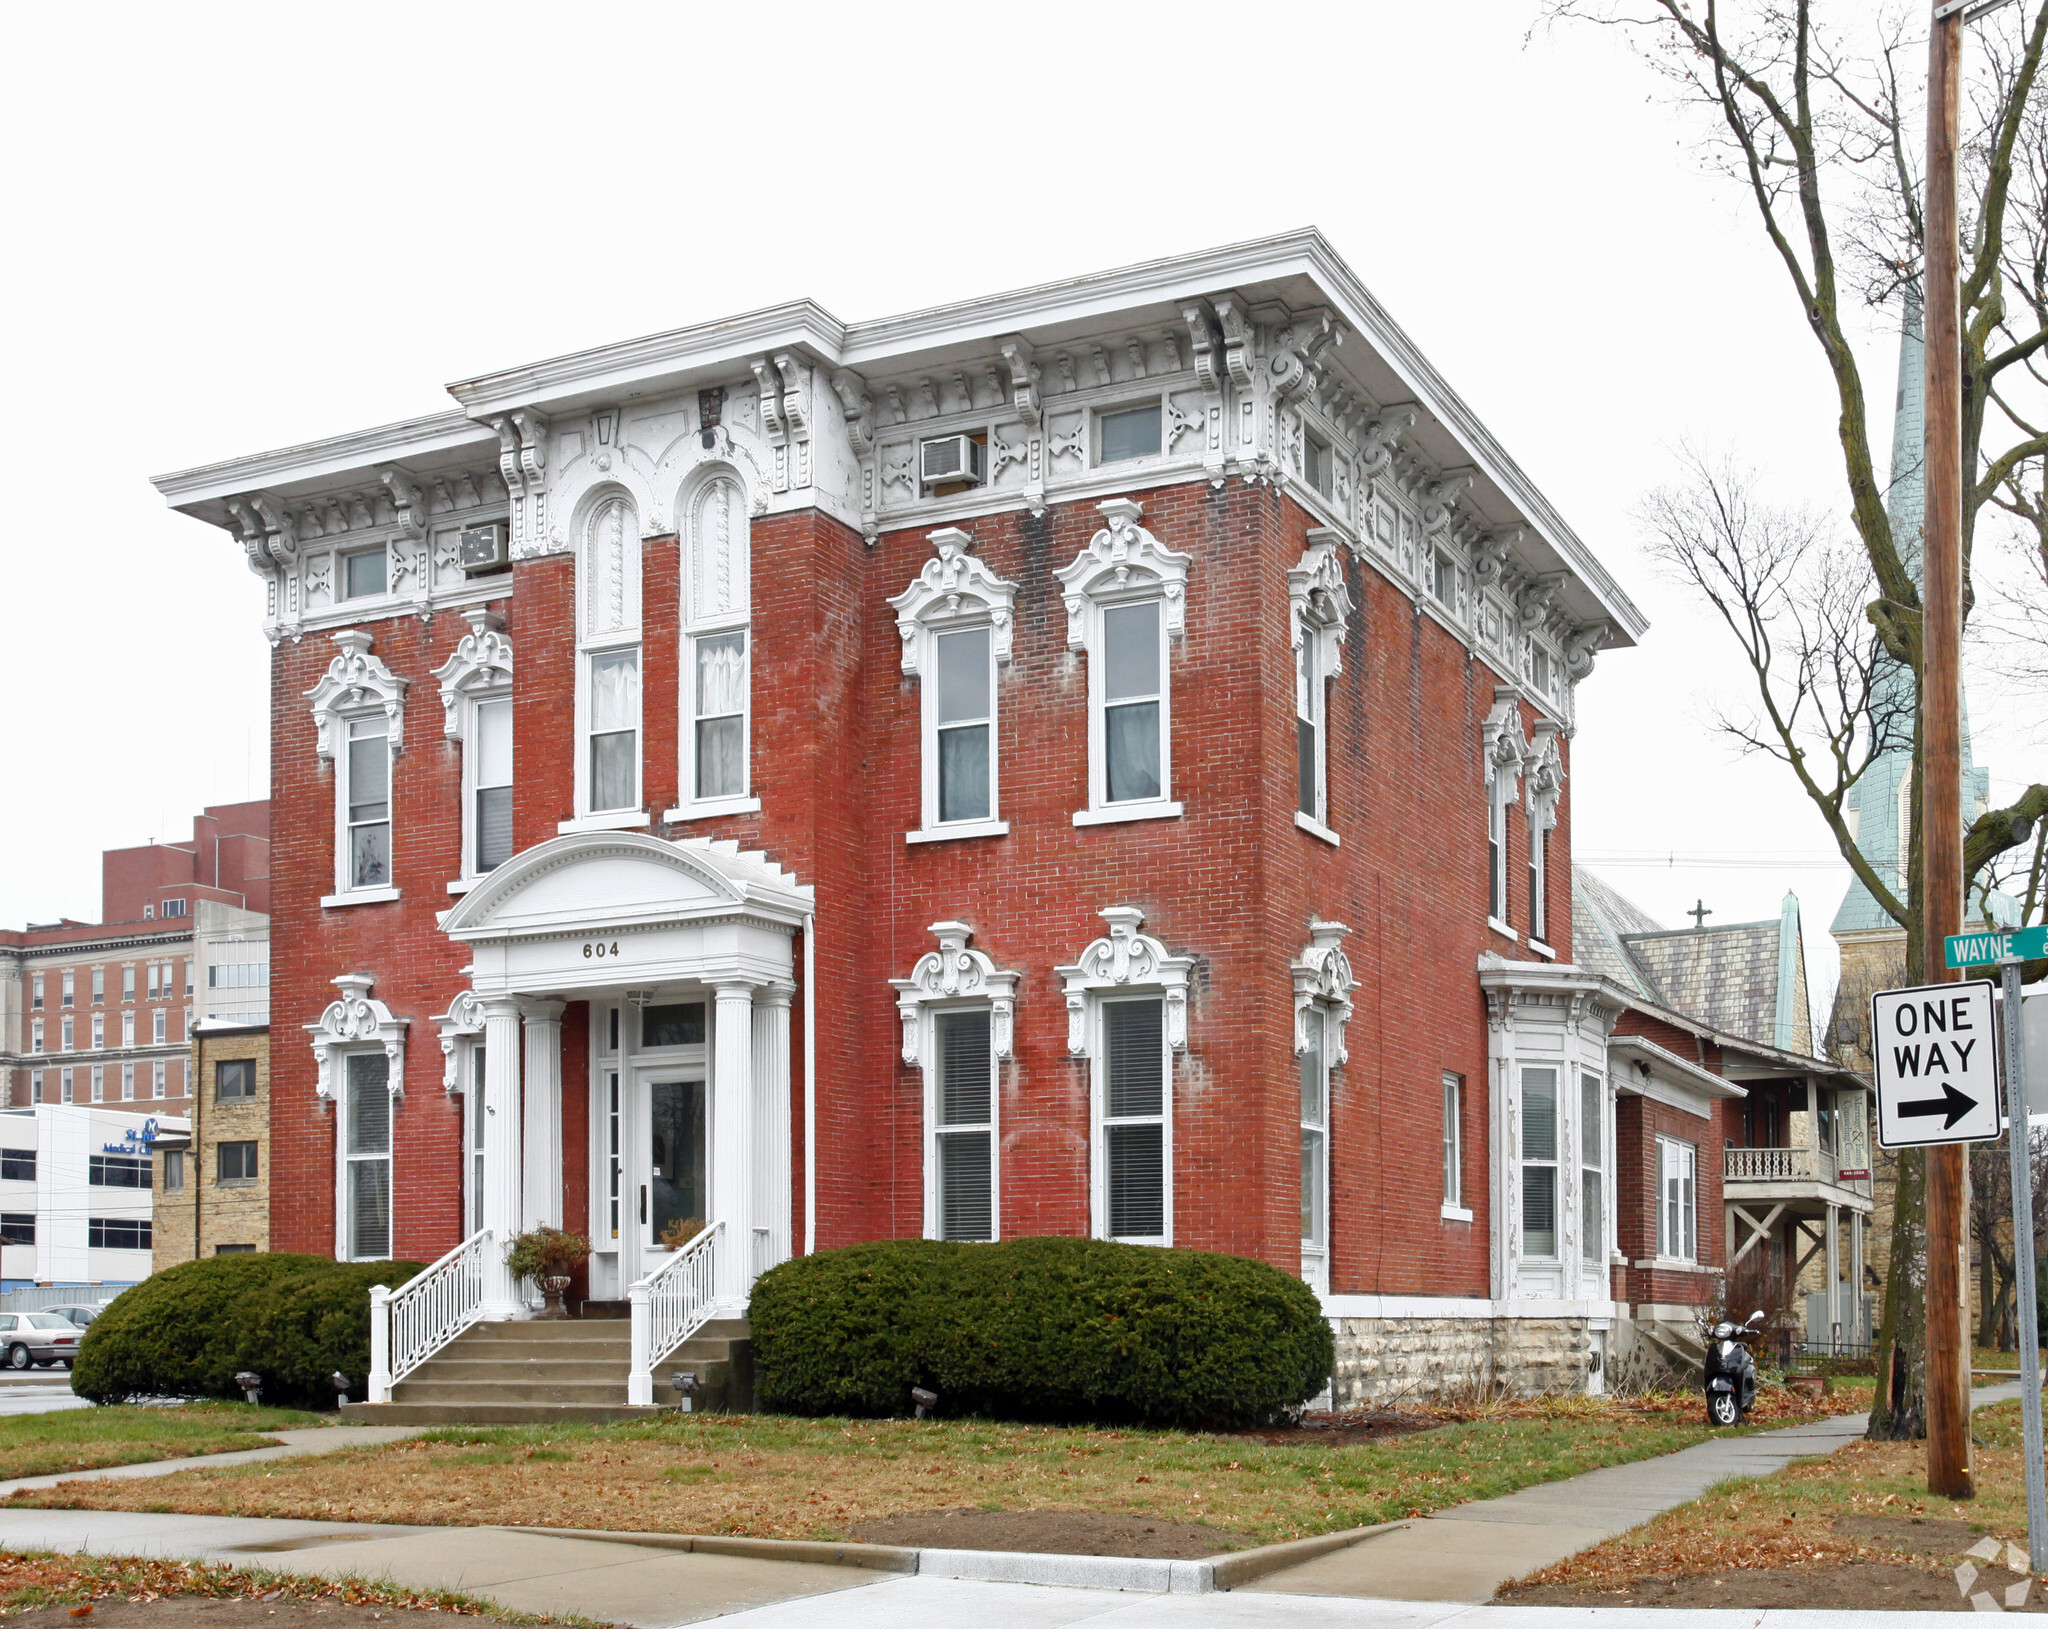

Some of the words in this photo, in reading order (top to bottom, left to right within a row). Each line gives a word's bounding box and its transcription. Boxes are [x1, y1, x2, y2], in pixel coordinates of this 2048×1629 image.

[583, 941, 619, 959] 604
[1953, 934, 2014, 963] WAYNE
[1895, 997, 1973, 1037] ONE
[1893, 1038, 1976, 1078] WAY
[1843, 1100, 1852, 1142] Counseling
[1853, 1096, 1862, 1129] Marriage
[103, 1142, 136, 1154] Medical
[1852, 1130, 1864, 1142] &
[1845, 1142, 1853, 1167] Center
[1855, 1143, 1864, 1166] Family
